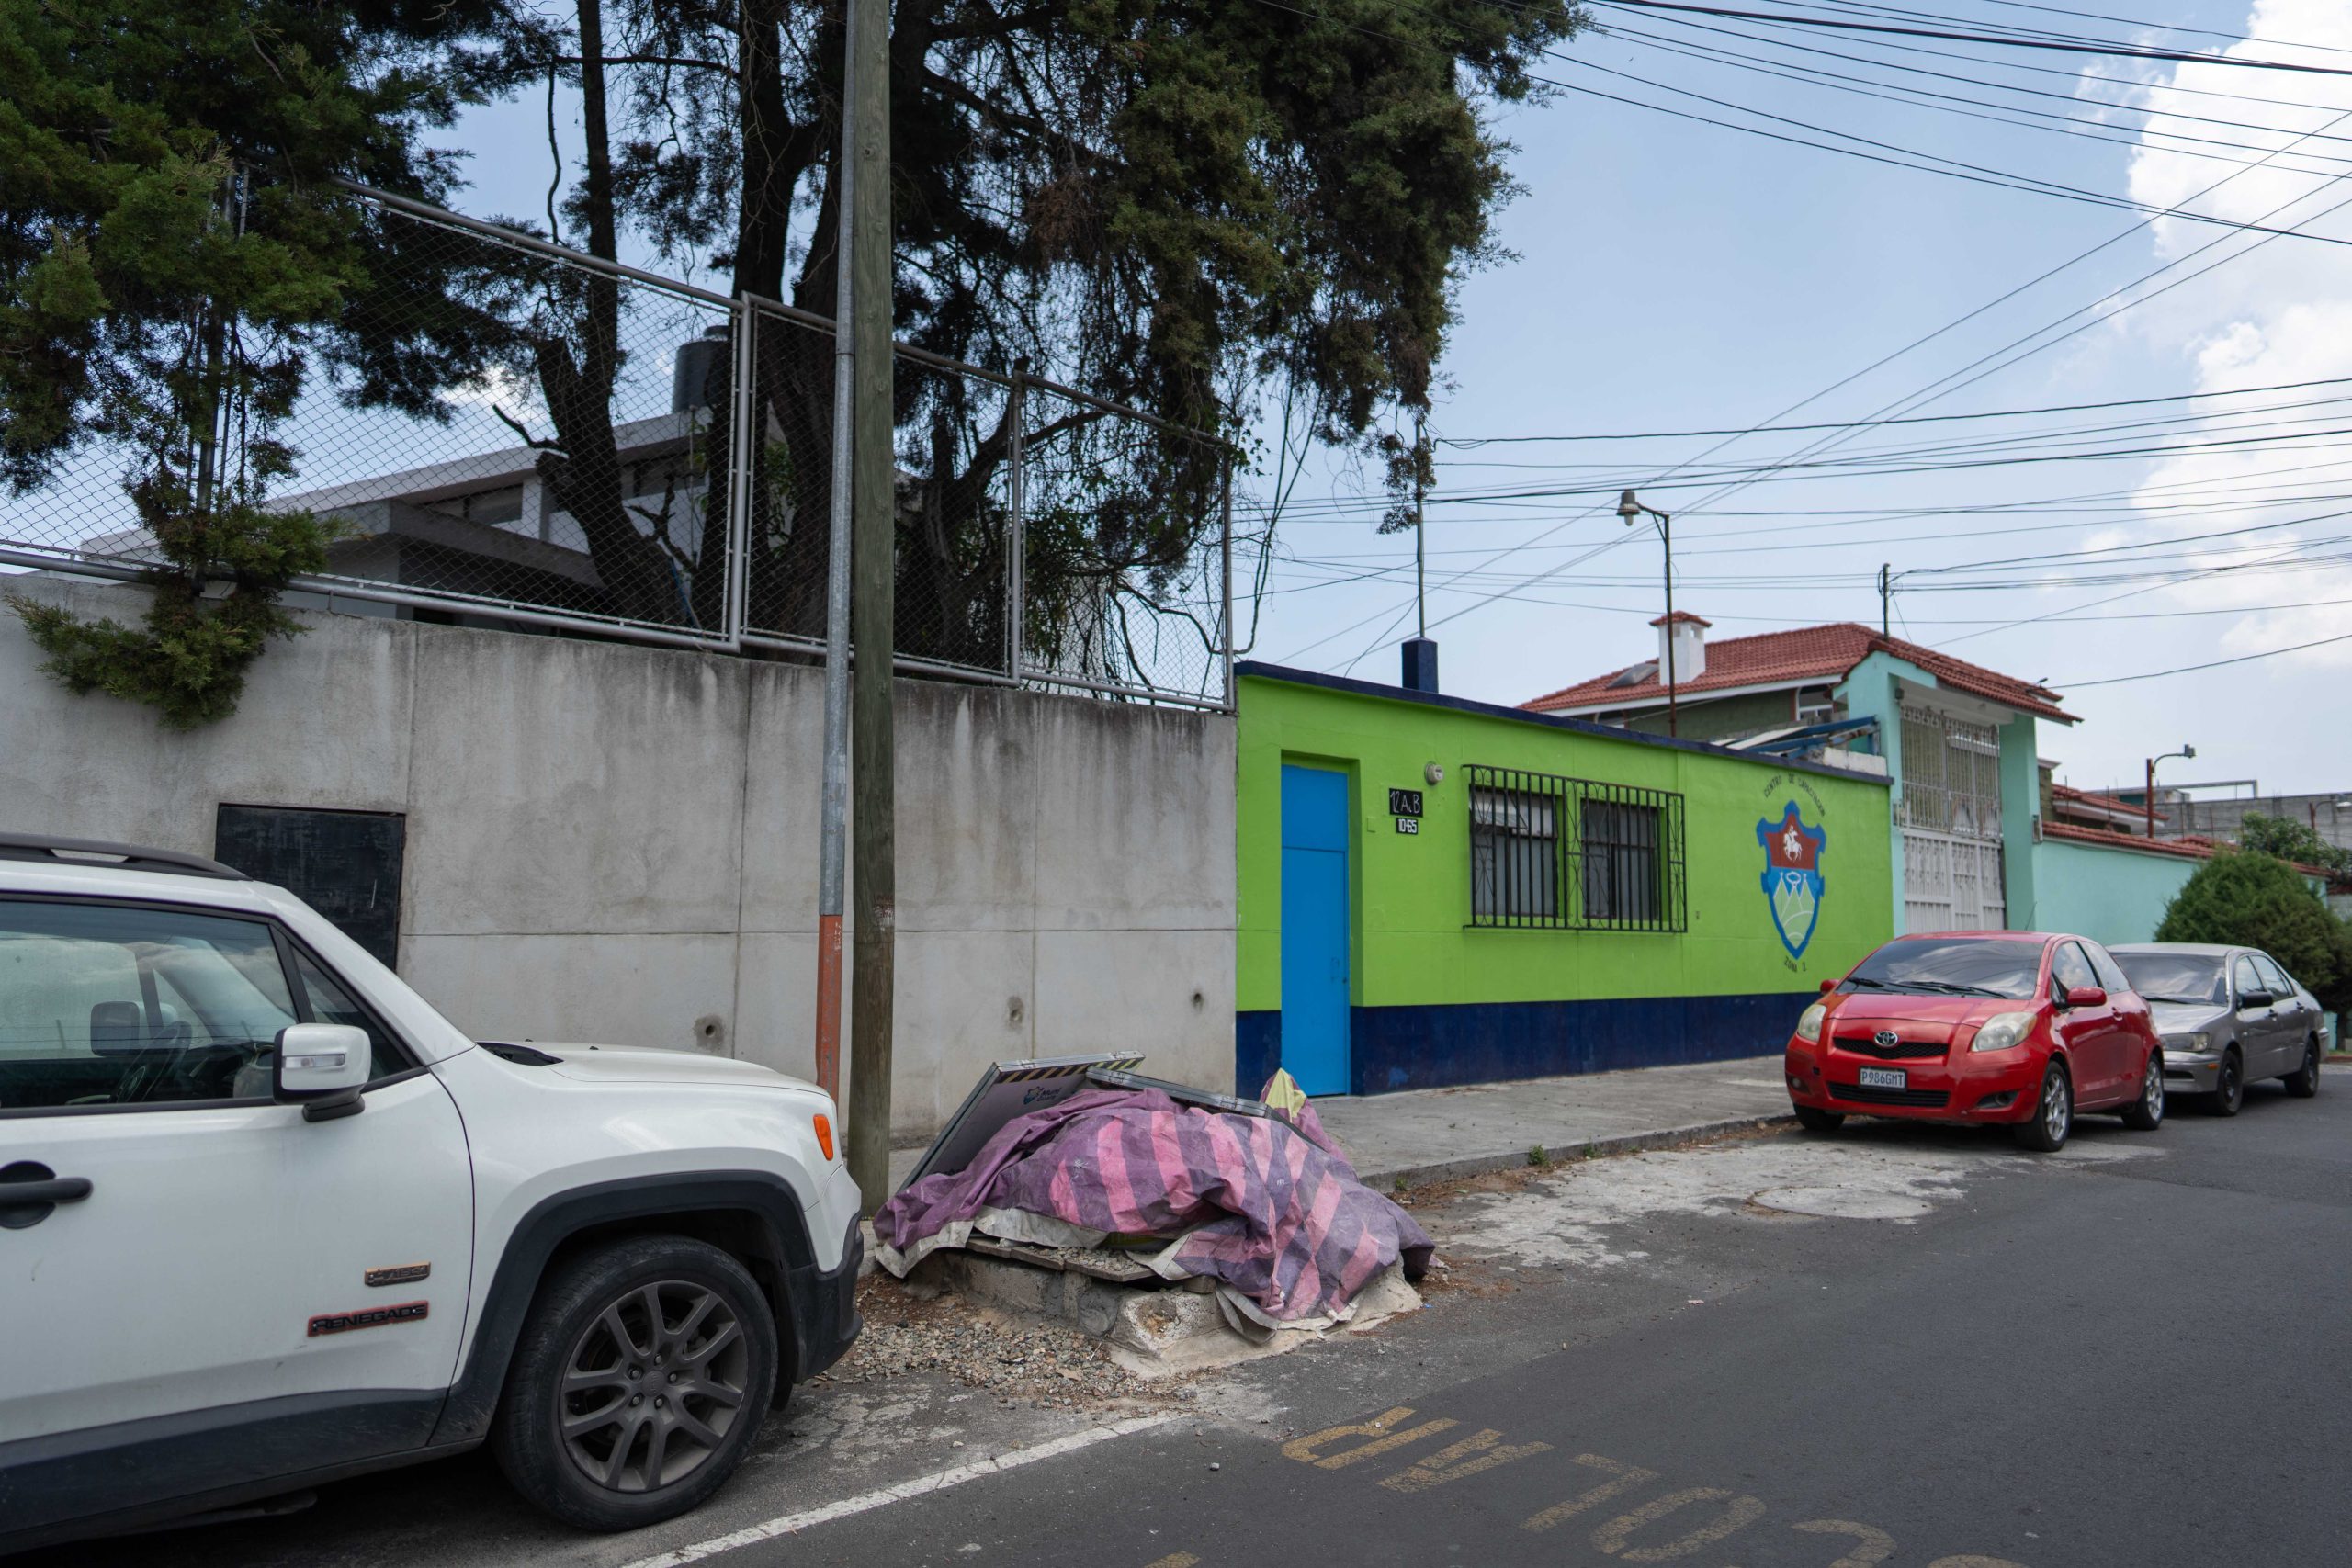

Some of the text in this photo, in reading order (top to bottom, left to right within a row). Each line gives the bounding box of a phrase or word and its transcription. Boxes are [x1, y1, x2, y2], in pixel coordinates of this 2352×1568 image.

[1764, 775, 1782, 798] CENTRO
[1788, 771, 1794, 784] DE
[1398, 818, 1418, 834] 10-65
[1784, 955, 1798, 973] ZONA
[1861, 1071, 1904, 1087] P986GMT
[311, 1304, 426, 1333] RENEGADE
